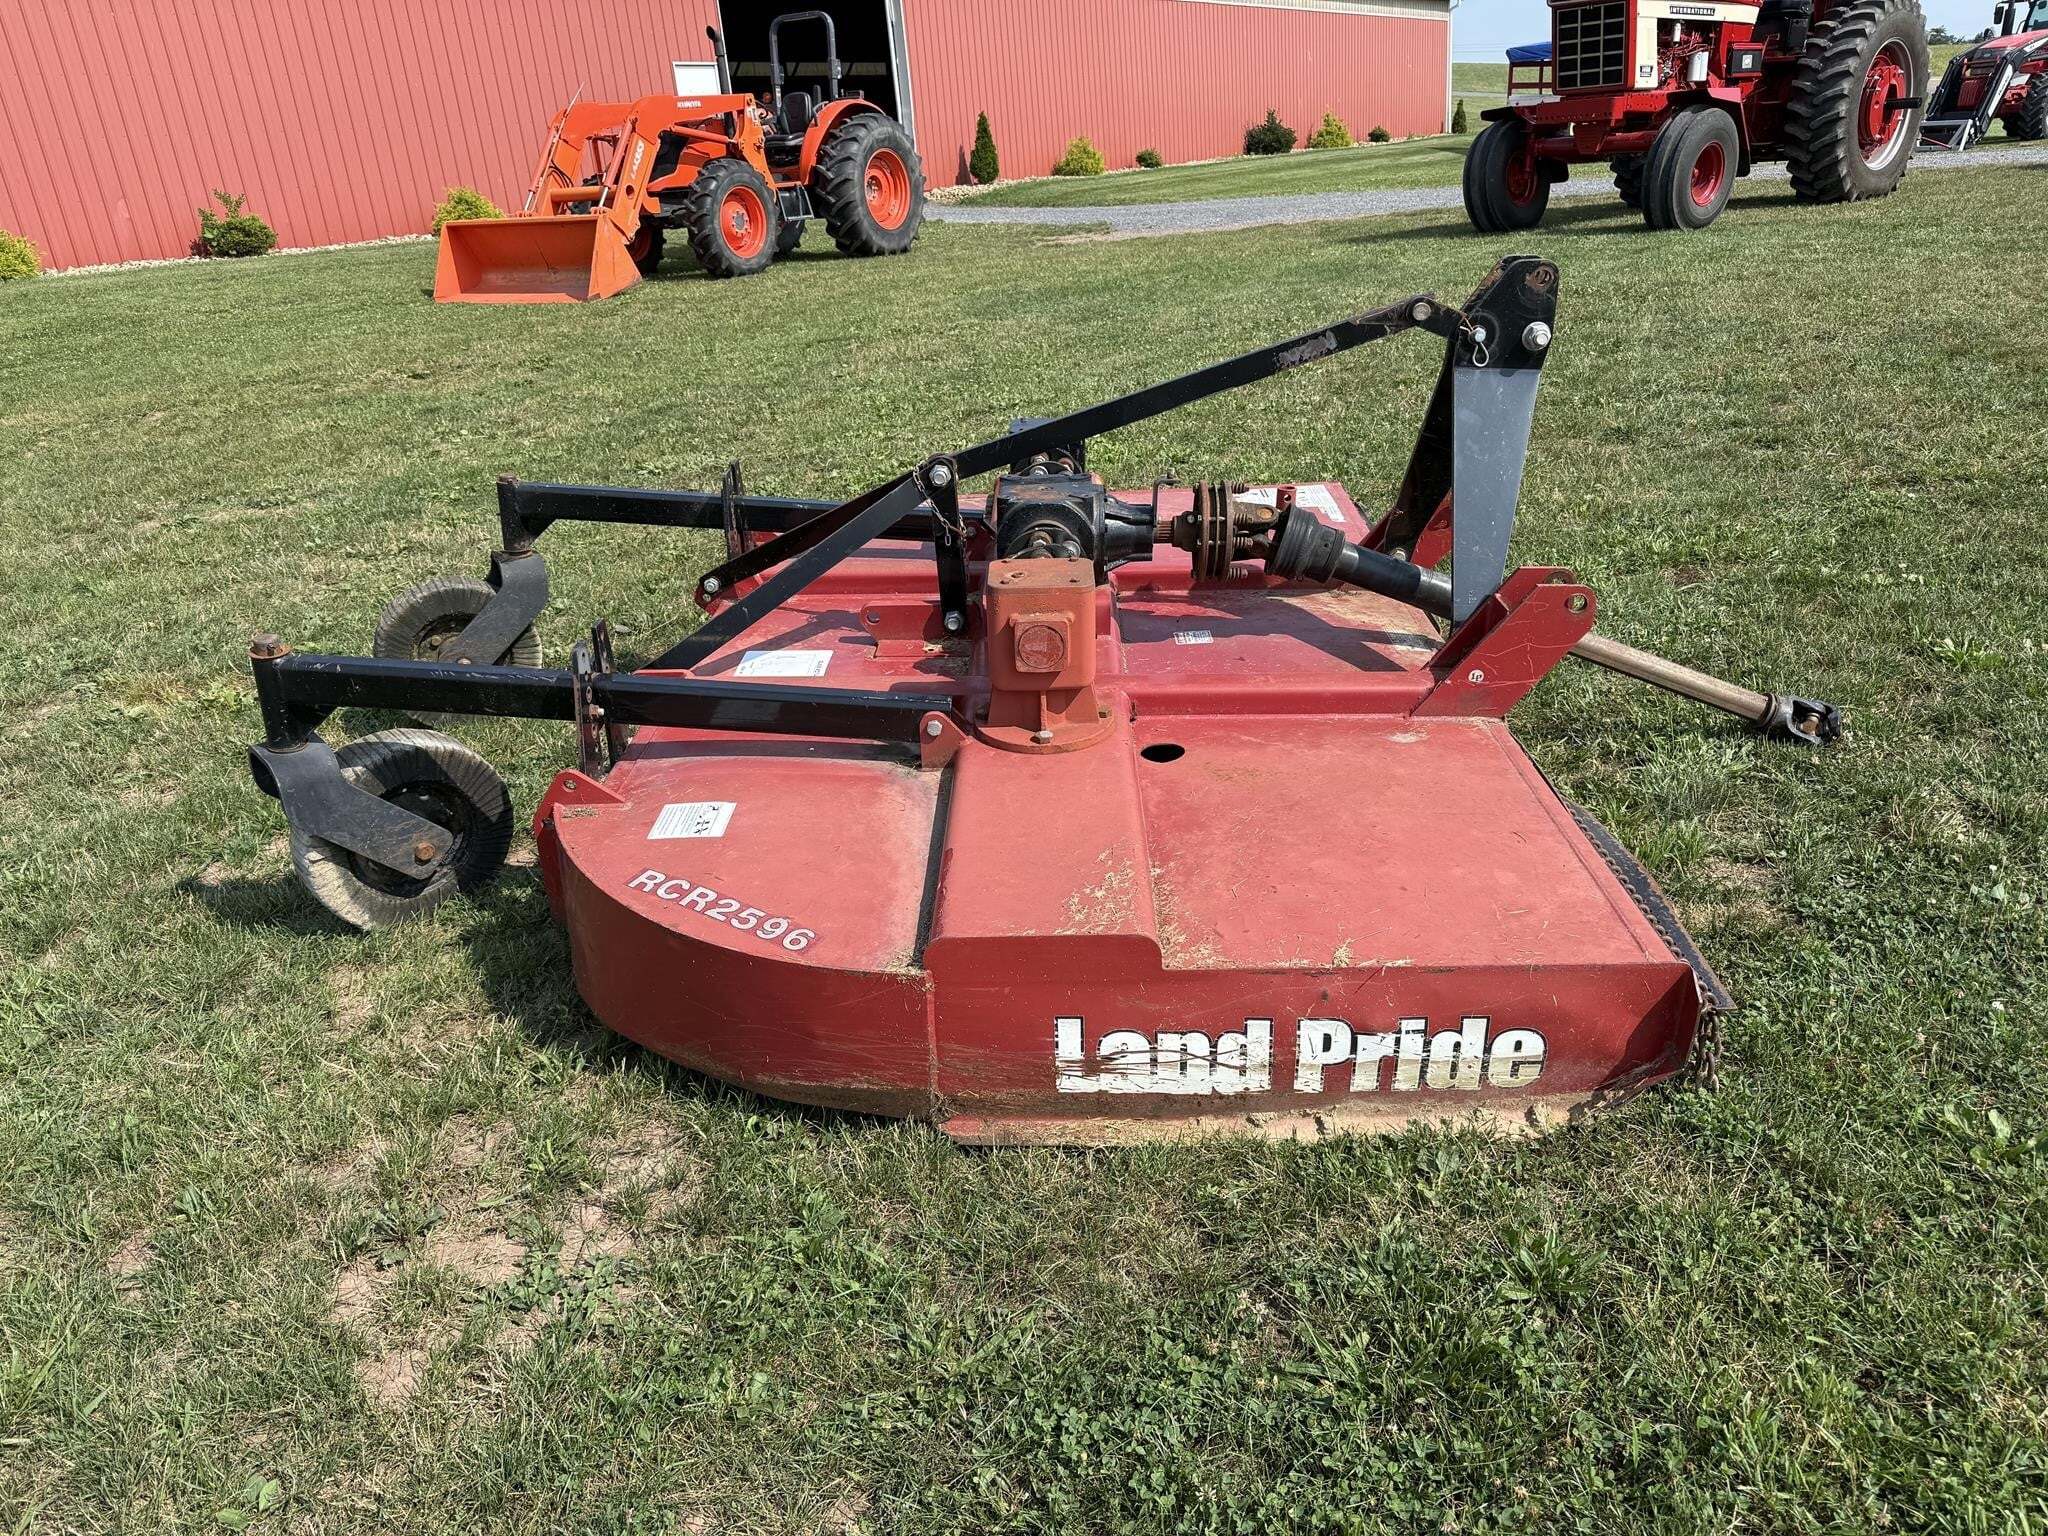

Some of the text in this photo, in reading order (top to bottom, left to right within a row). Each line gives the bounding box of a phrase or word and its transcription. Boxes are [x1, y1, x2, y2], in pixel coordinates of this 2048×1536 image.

[1670, 6, 1715, 15] INTERNATIONAL
[627, 868, 816, 951] RCR2596
[1055, 1016, 1547, 1095] Land Pride
